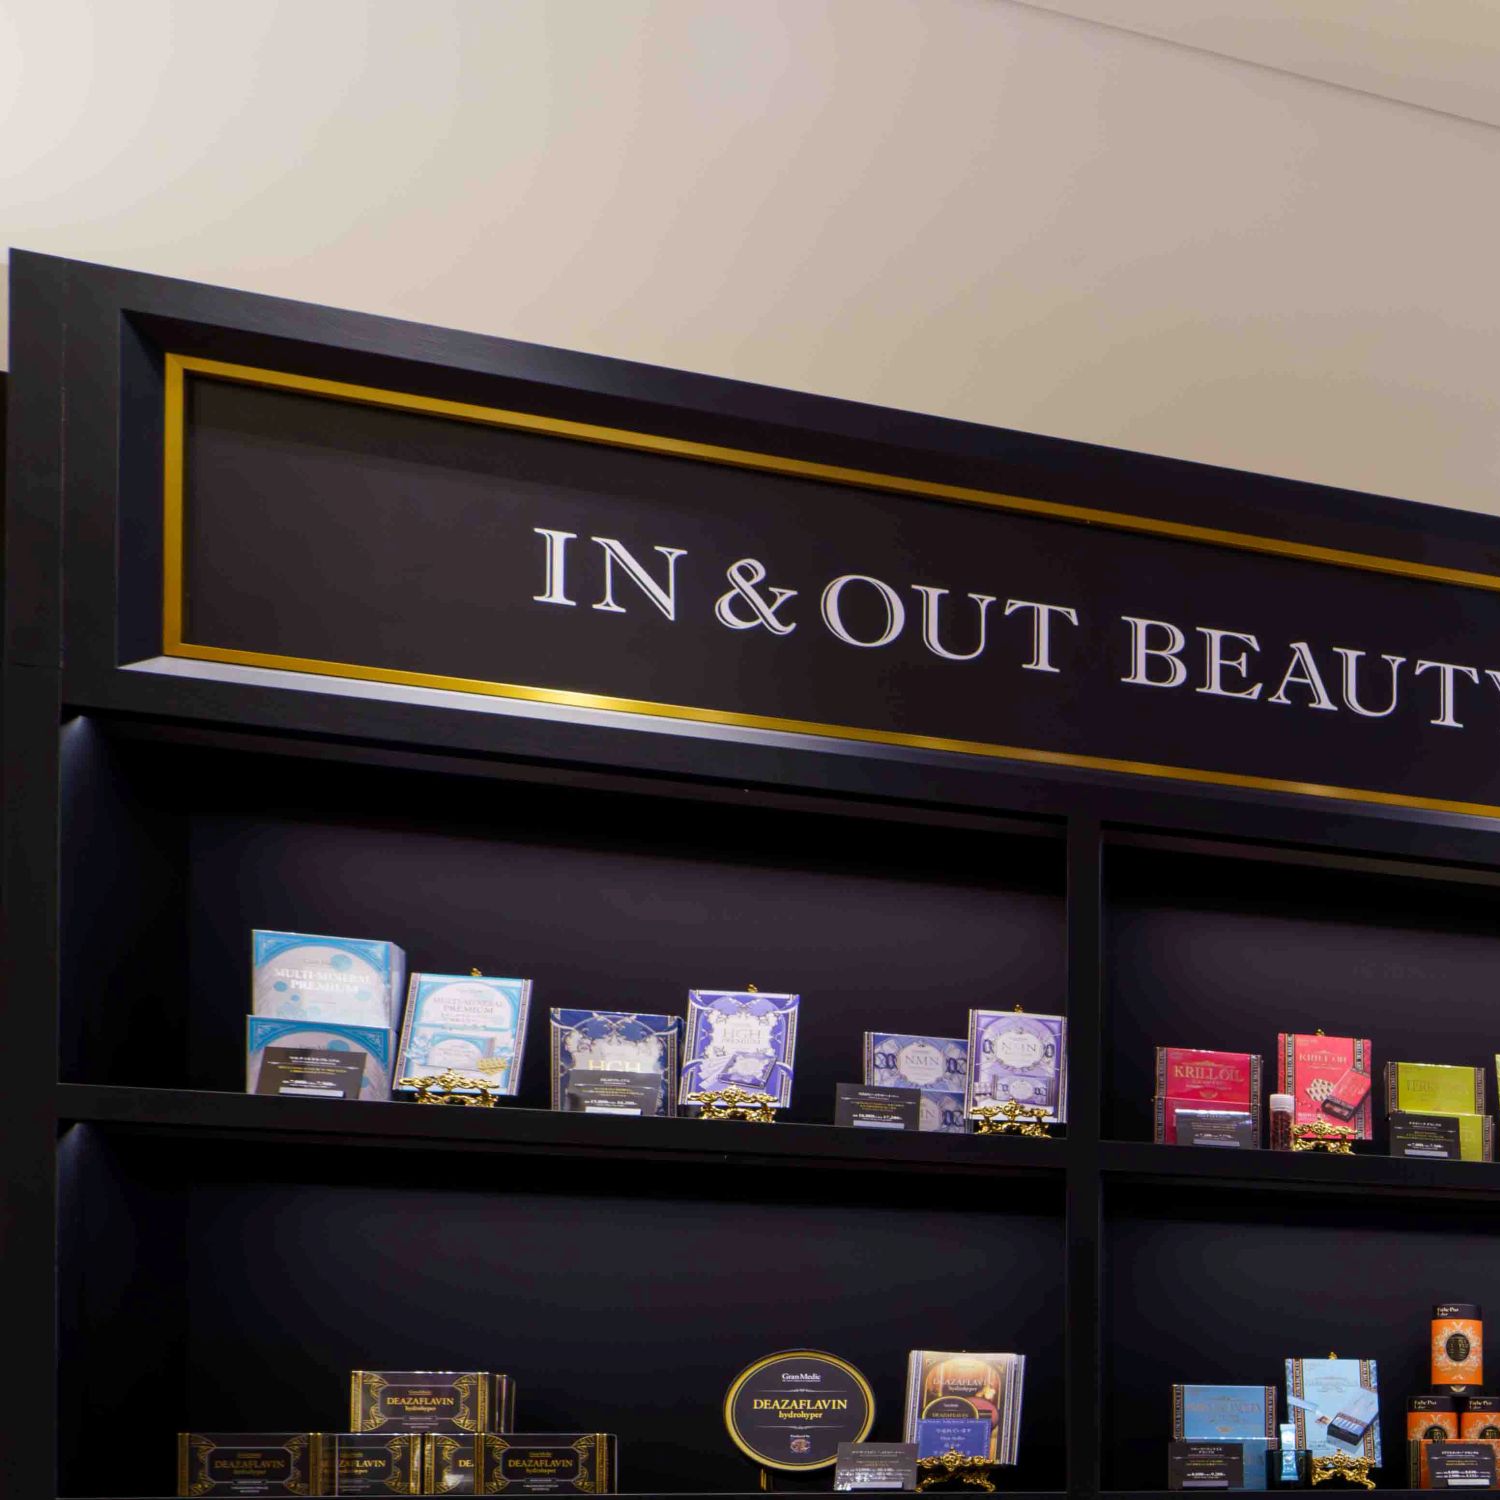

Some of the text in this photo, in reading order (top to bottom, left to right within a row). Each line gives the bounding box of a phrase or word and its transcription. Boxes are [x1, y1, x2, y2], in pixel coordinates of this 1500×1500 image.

[533, 526, 689, 622] IN
[715, 557, 798, 637] &
[820, 570, 1080, 675] OUT
[905, 1055, 940, 1067] NMN
[1173, 1065, 1244, 1082] KRILL OIL
[386, 1397, 454, 1407] DEAZAFLAVIN
[752, 1398, 848, 1411] DEAZAFLAVIN
[778, 1410, 823, 1420] hydrohyper
[213, 1459, 285, 1469] DEAZAFLAVIN
[507, 1458, 573, 1469] DEAZAFLAVIN
